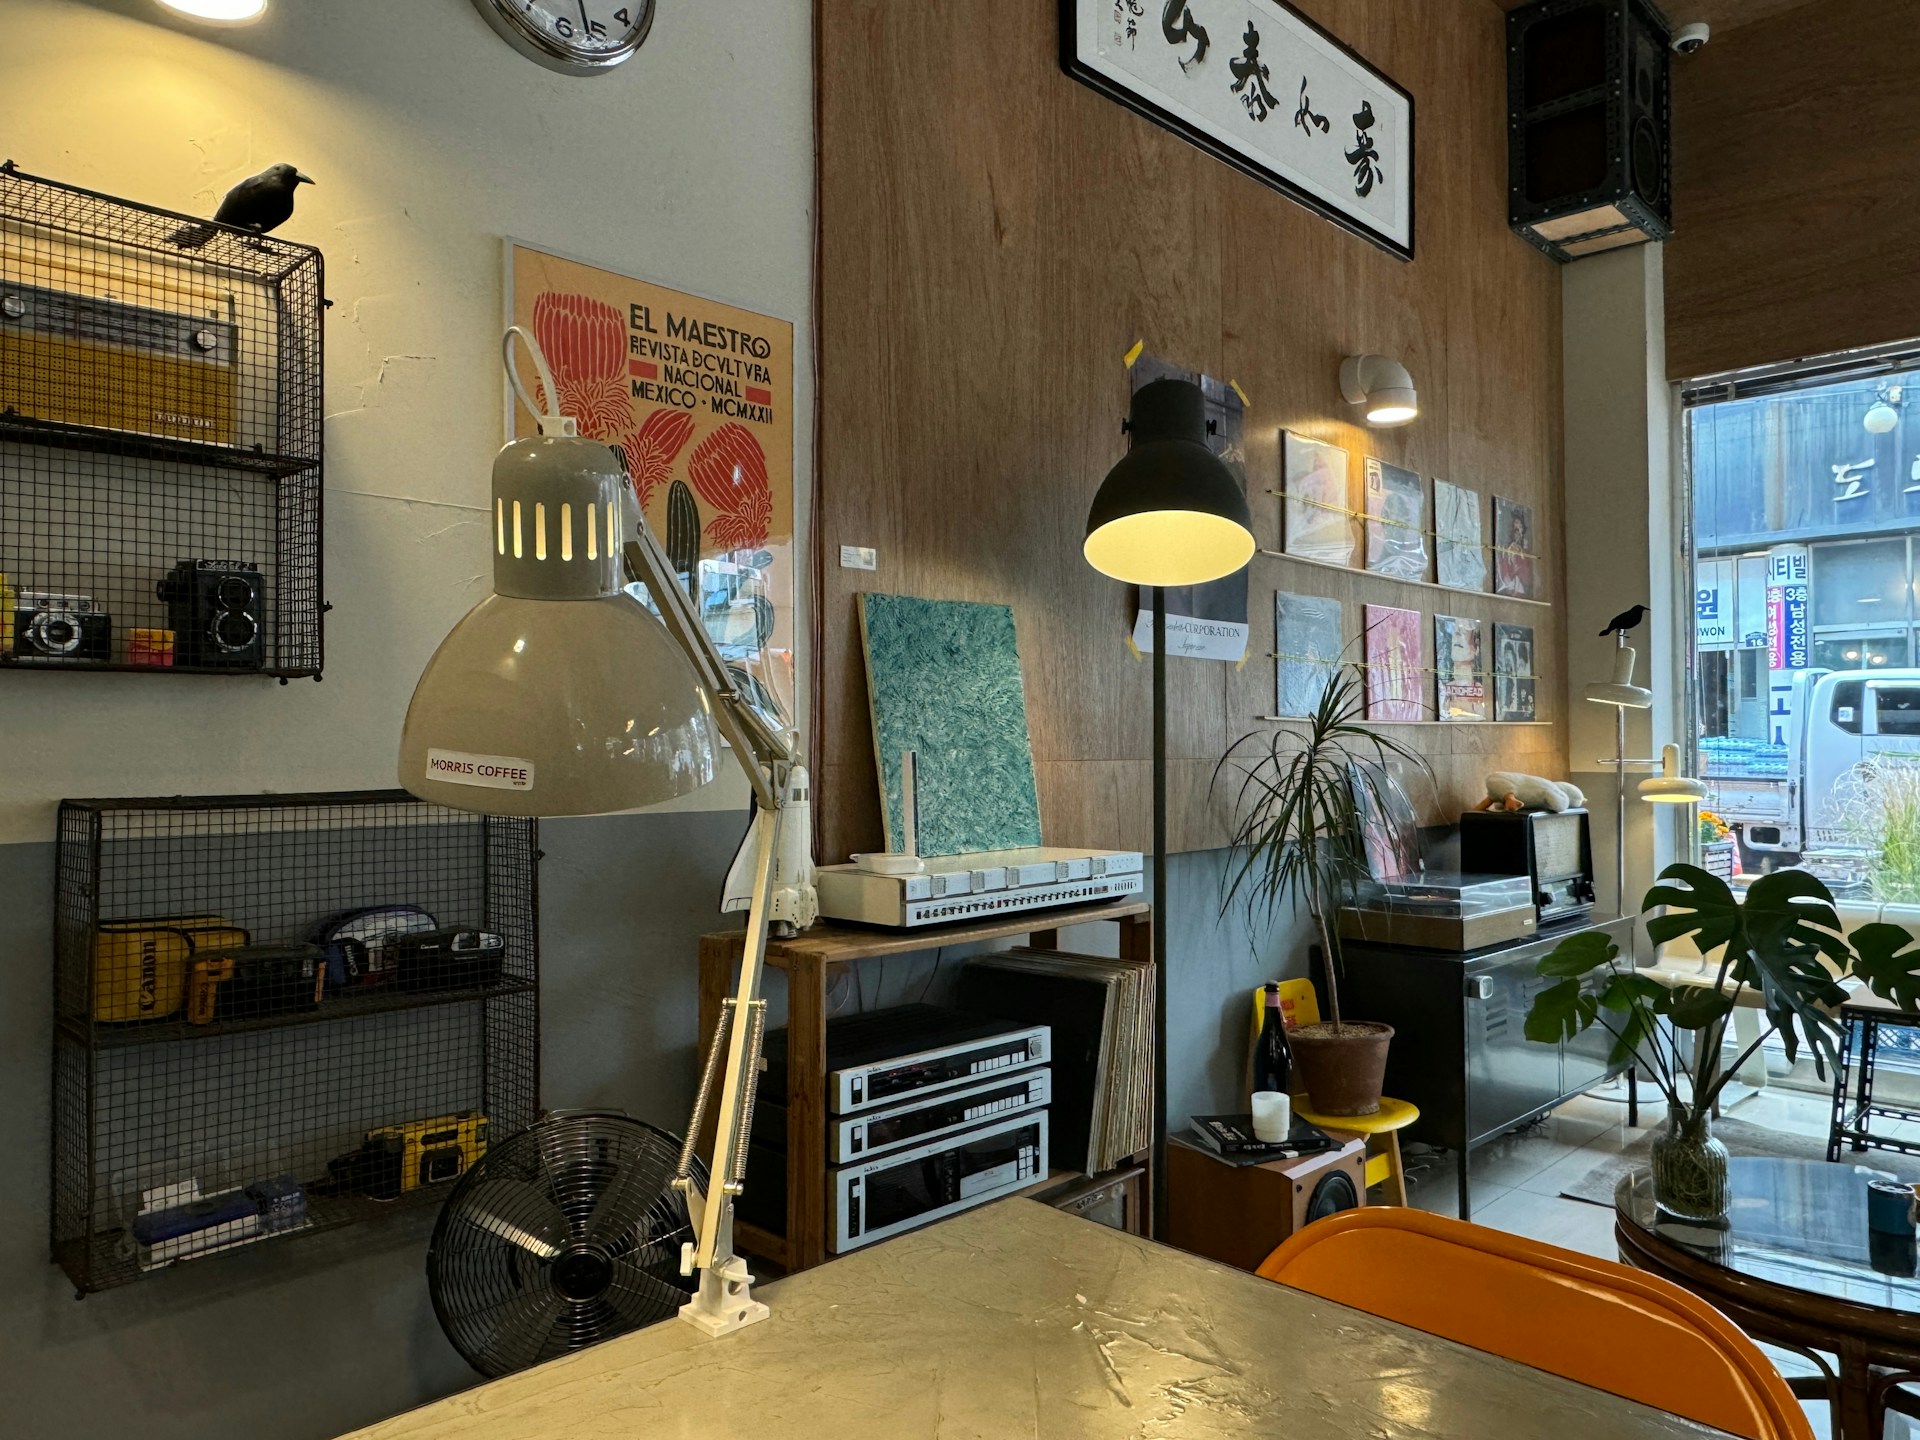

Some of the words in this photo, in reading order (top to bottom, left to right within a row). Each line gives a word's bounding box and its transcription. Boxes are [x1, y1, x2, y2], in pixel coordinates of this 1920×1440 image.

[555, 16, 574, 38] 6
[613, 7, 631, 28] 4
[630, 303, 657, 334] EL
[666, 312, 772, 359] MAESTRO
[630, 335, 688, 366] REVISTA
[663, 364, 742, 398] NACIONAL
[631, 379, 696, 410] MEXICO
[711, 396, 773, 425] MCMXXII
[1785, 586, 1808, 602] 3층
[1750, 638, 1764, 647] 16
[1789, 603, 1807, 667] 남성전용
[430, 758, 474, 775] MORRIS
[477, 765, 528, 780] COFFEE
[141, 941, 156, 1011] Canon
